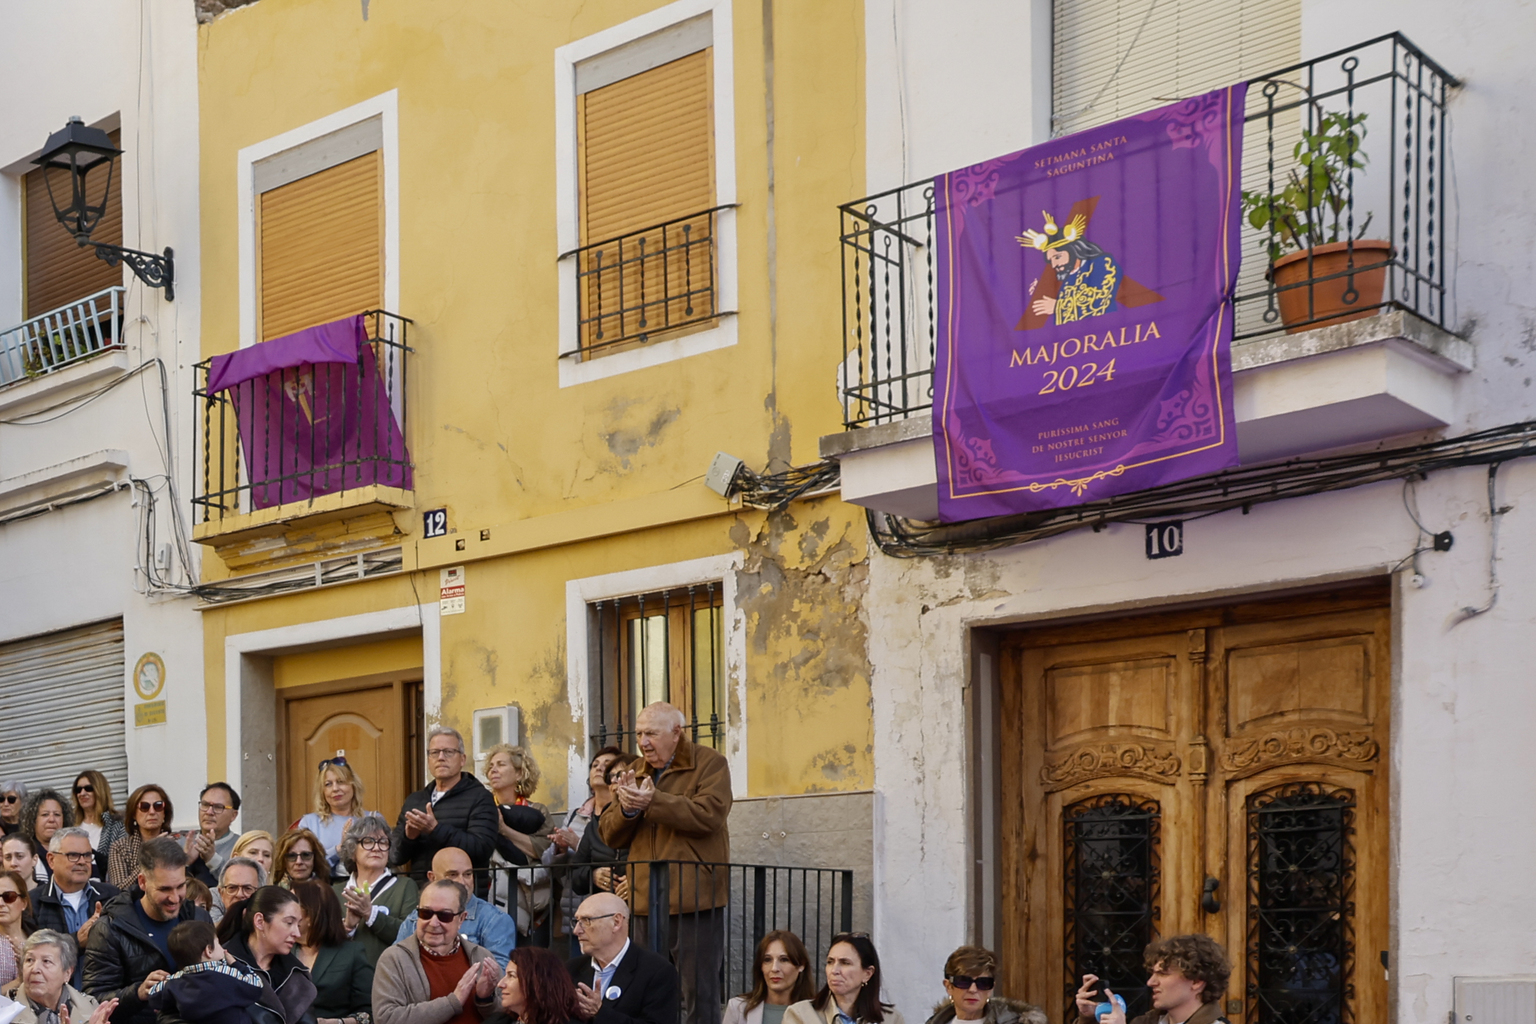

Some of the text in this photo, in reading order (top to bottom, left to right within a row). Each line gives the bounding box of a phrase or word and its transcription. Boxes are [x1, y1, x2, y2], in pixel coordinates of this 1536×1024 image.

[1034, 135, 1128, 169] SETMANA SANTA
[1047, 152, 1115, 178] SAGUNTINA
[1009, 321, 1161, 368] MAJORALIA
[1038, 358, 1116, 395] 2024
[1038, 417, 1119, 440] PURÍSSIMA SANG
[1031, 429, 1128, 454] DE NOSTRE SENYOR
[1054, 446, 1104, 463] JESUCRIST
[426, 512, 446, 537] 12
[1149, 525, 1181, 555] 10
[442, 587, 464, 595] Alarma
